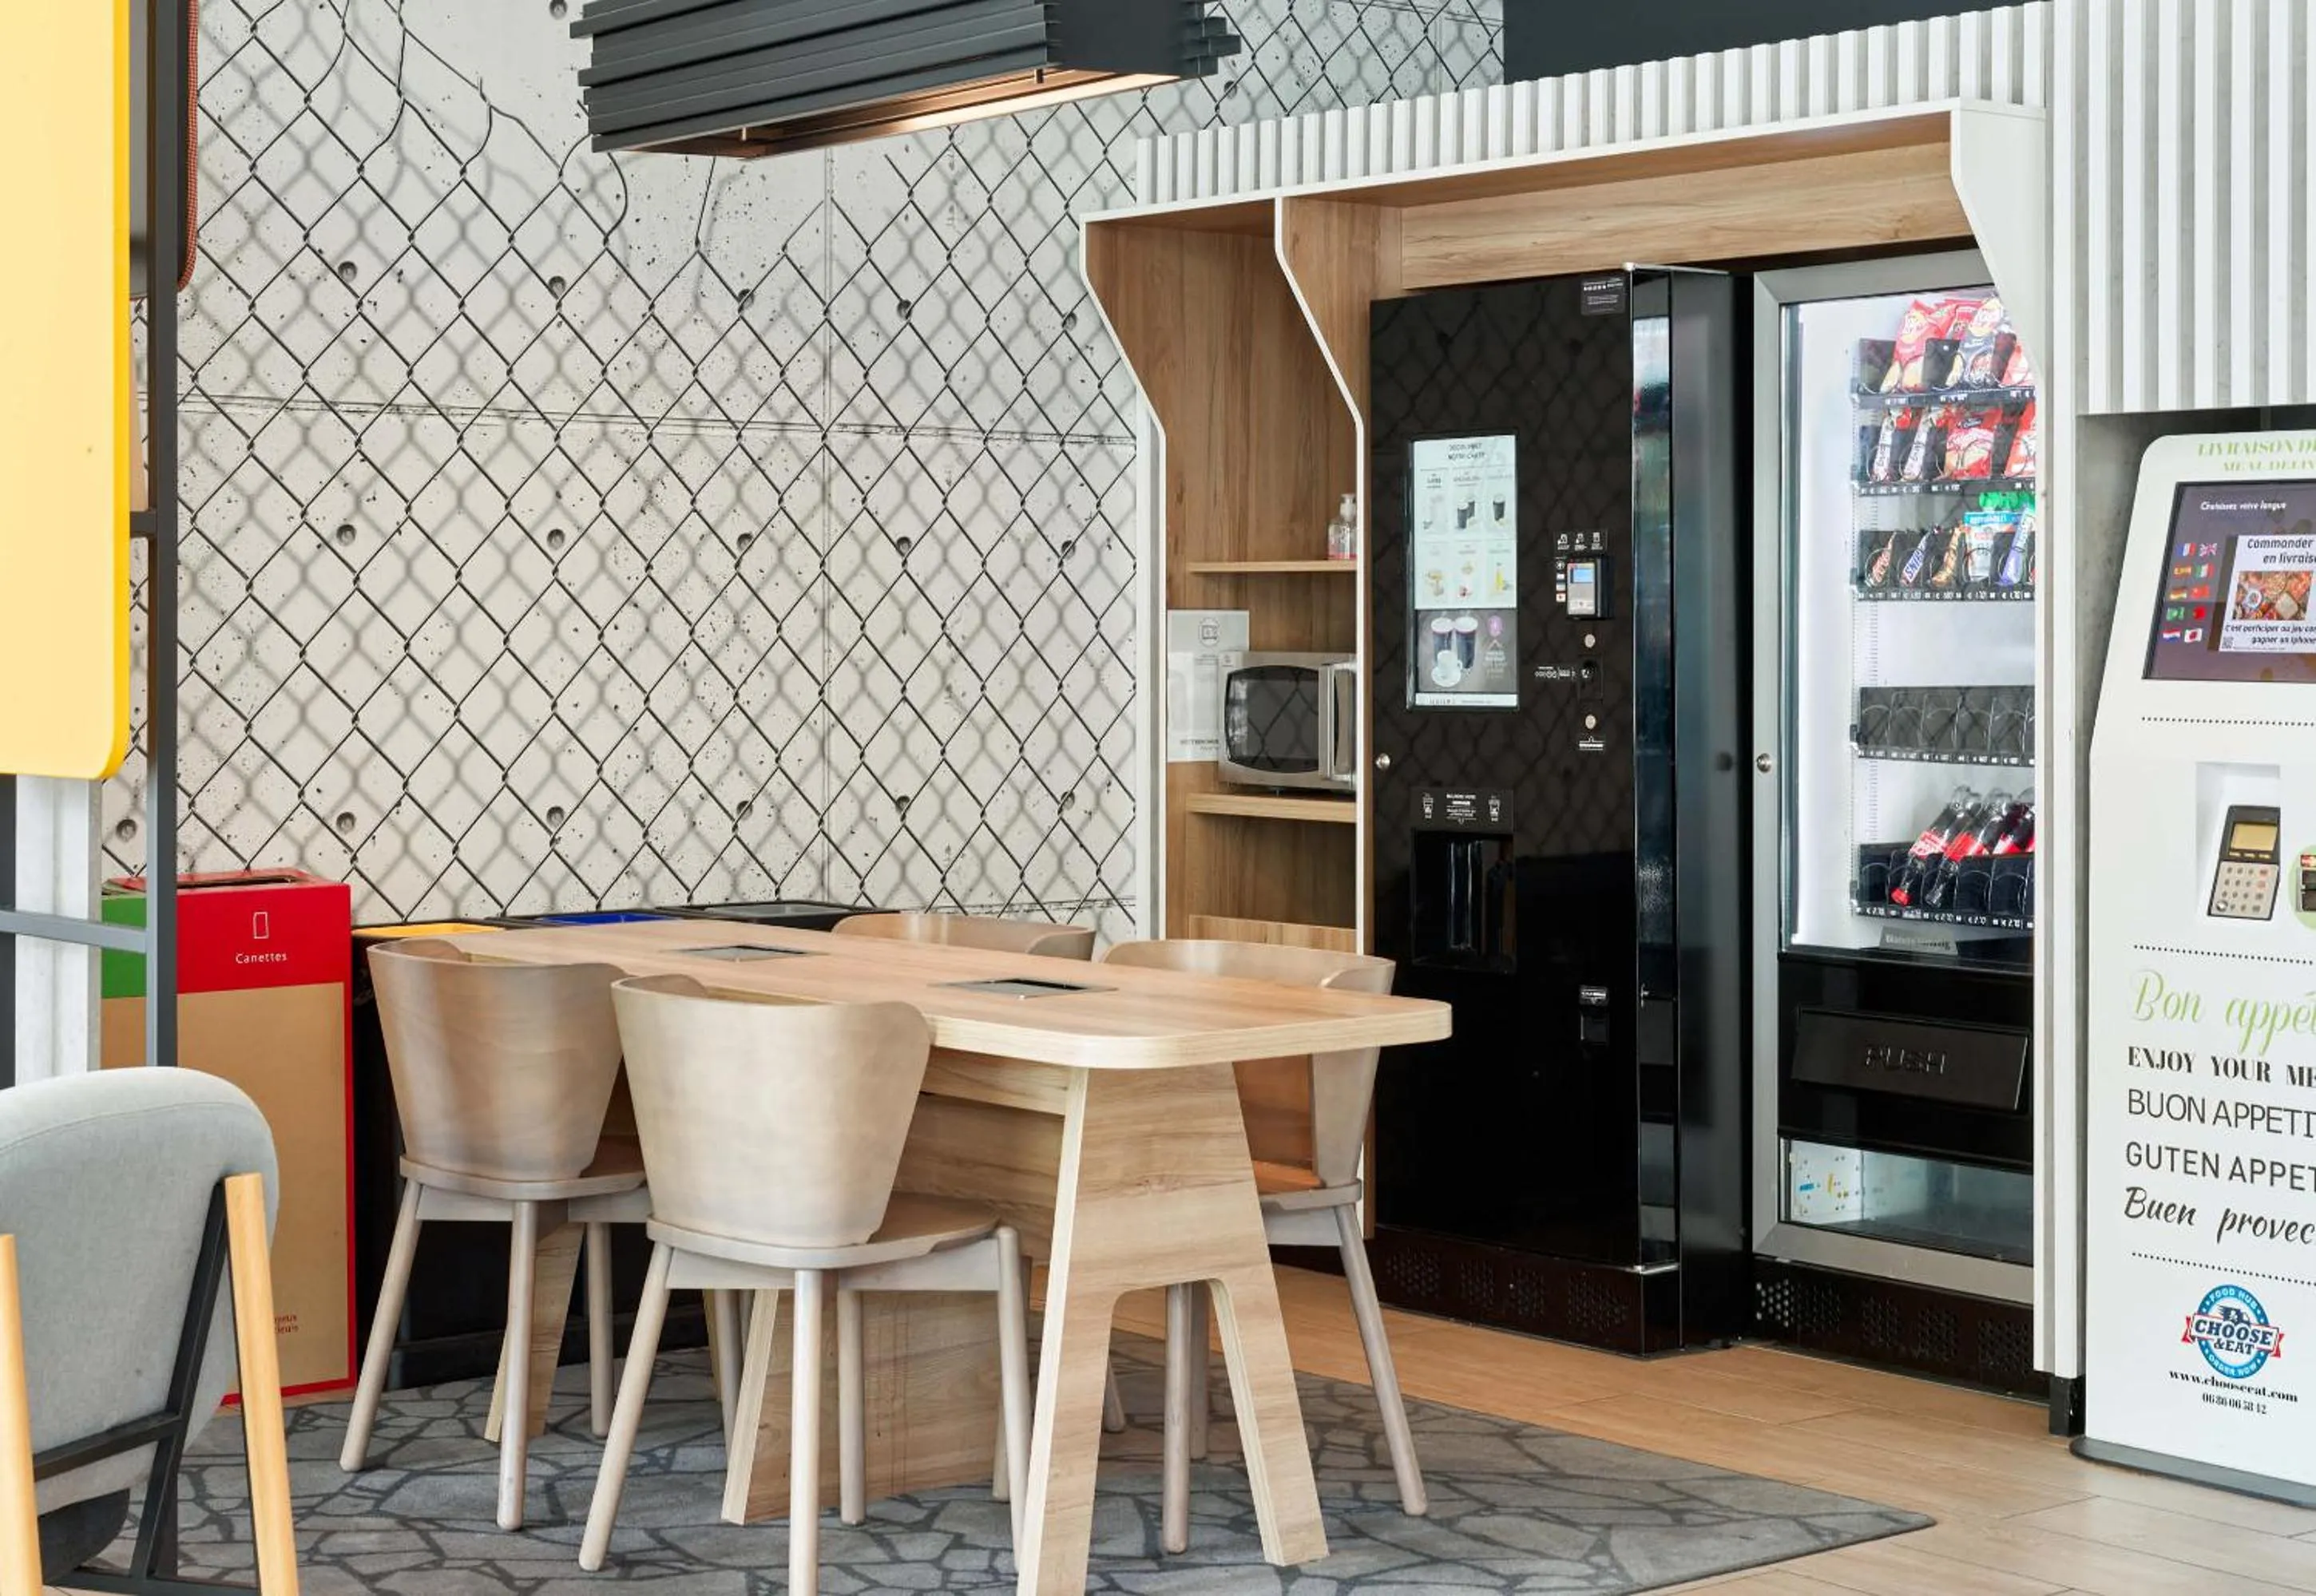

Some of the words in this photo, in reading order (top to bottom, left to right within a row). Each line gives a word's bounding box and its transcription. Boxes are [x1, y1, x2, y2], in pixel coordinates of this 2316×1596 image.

[2260, 499, 2286, 512] langue
[2247, 538, 2314, 549] Commander
[2262, 554, 2277, 564] en
[236, 951, 288, 964] Canettes
[2131, 968, 2202, 1024] Bon
[1866, 1045, 1947, 1075] PUSH
[2128, 1046, 2195, 1073] ENJOY
[2211, 1055, 2271, 1083] YOUR
[2128, 1088, 2207, 1124] BUON
[2125, 1141, 2220, 1179] GUTEN
[2124, 1186, 2197, 1226] Buen
[2216, 1207, 2316, 1245] provec
[2209, 1287, 2235, 1304] FOOD
[2239, 1290, 2258, 1310] HUB
[2195, 1319, 2274, 1346] CHOOSE
[2213, 1338, 2255, 1356] &EAT
[2209, 1355, 2236, 1376] ORDER
[2239, 1361, 2258, 1376] NOW
